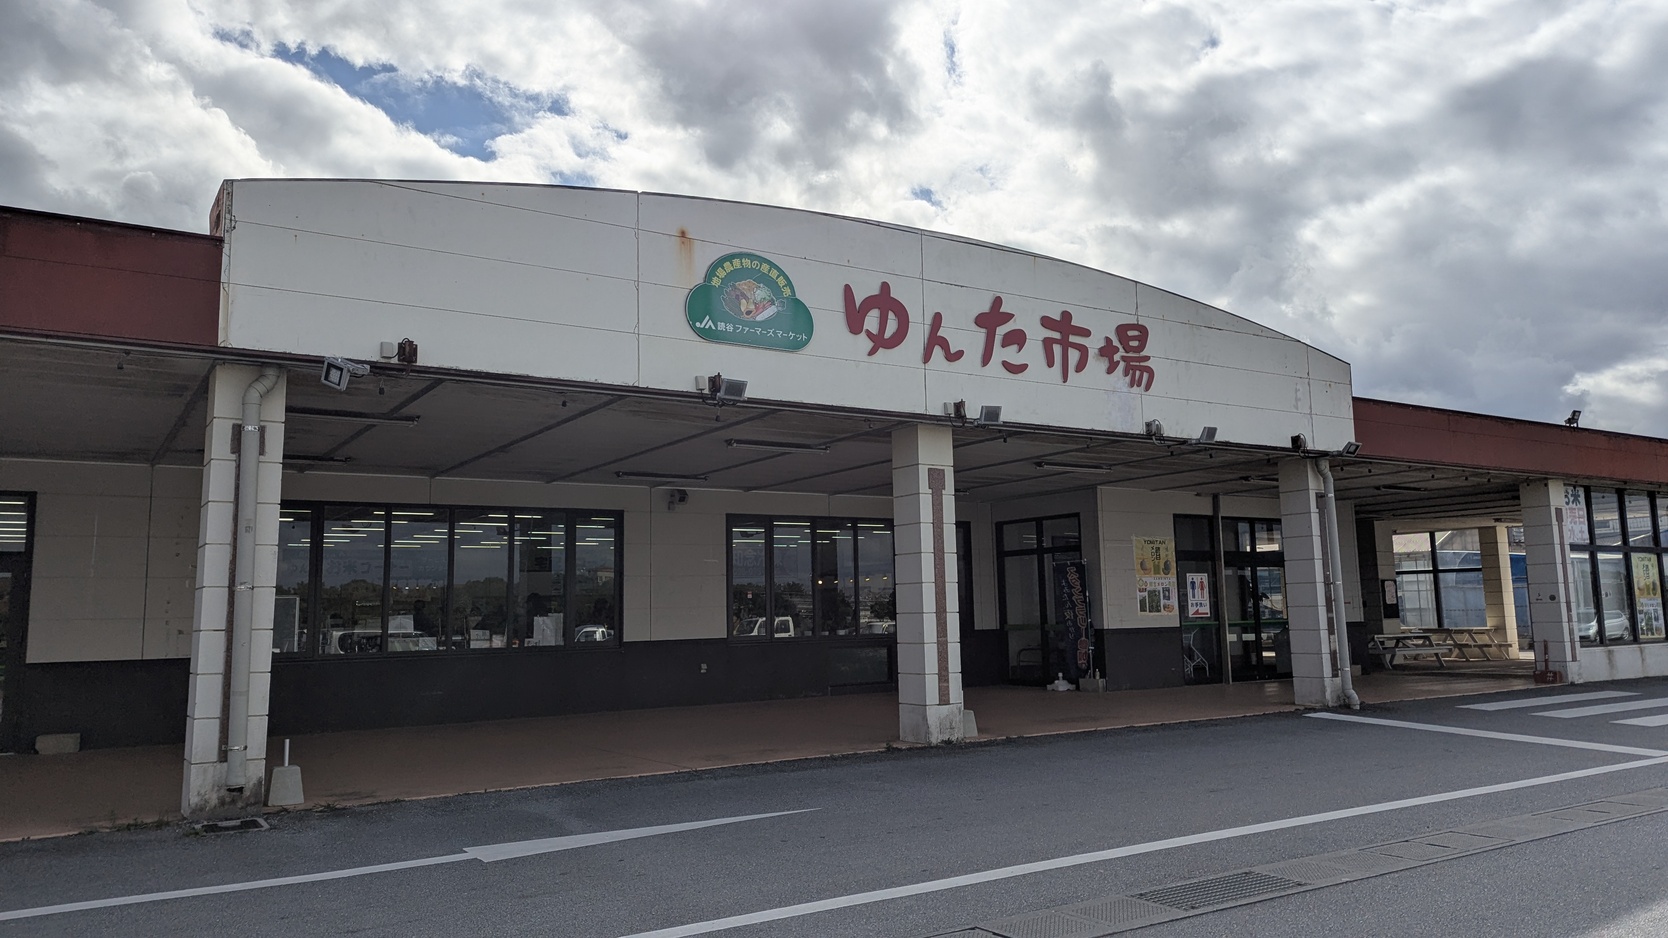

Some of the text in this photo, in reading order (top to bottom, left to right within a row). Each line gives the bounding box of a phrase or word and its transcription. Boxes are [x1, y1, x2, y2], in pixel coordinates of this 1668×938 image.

[843, 280, 1156, 392] ゆんた市場
[1190, 601, 1208, 609] お手洗い
